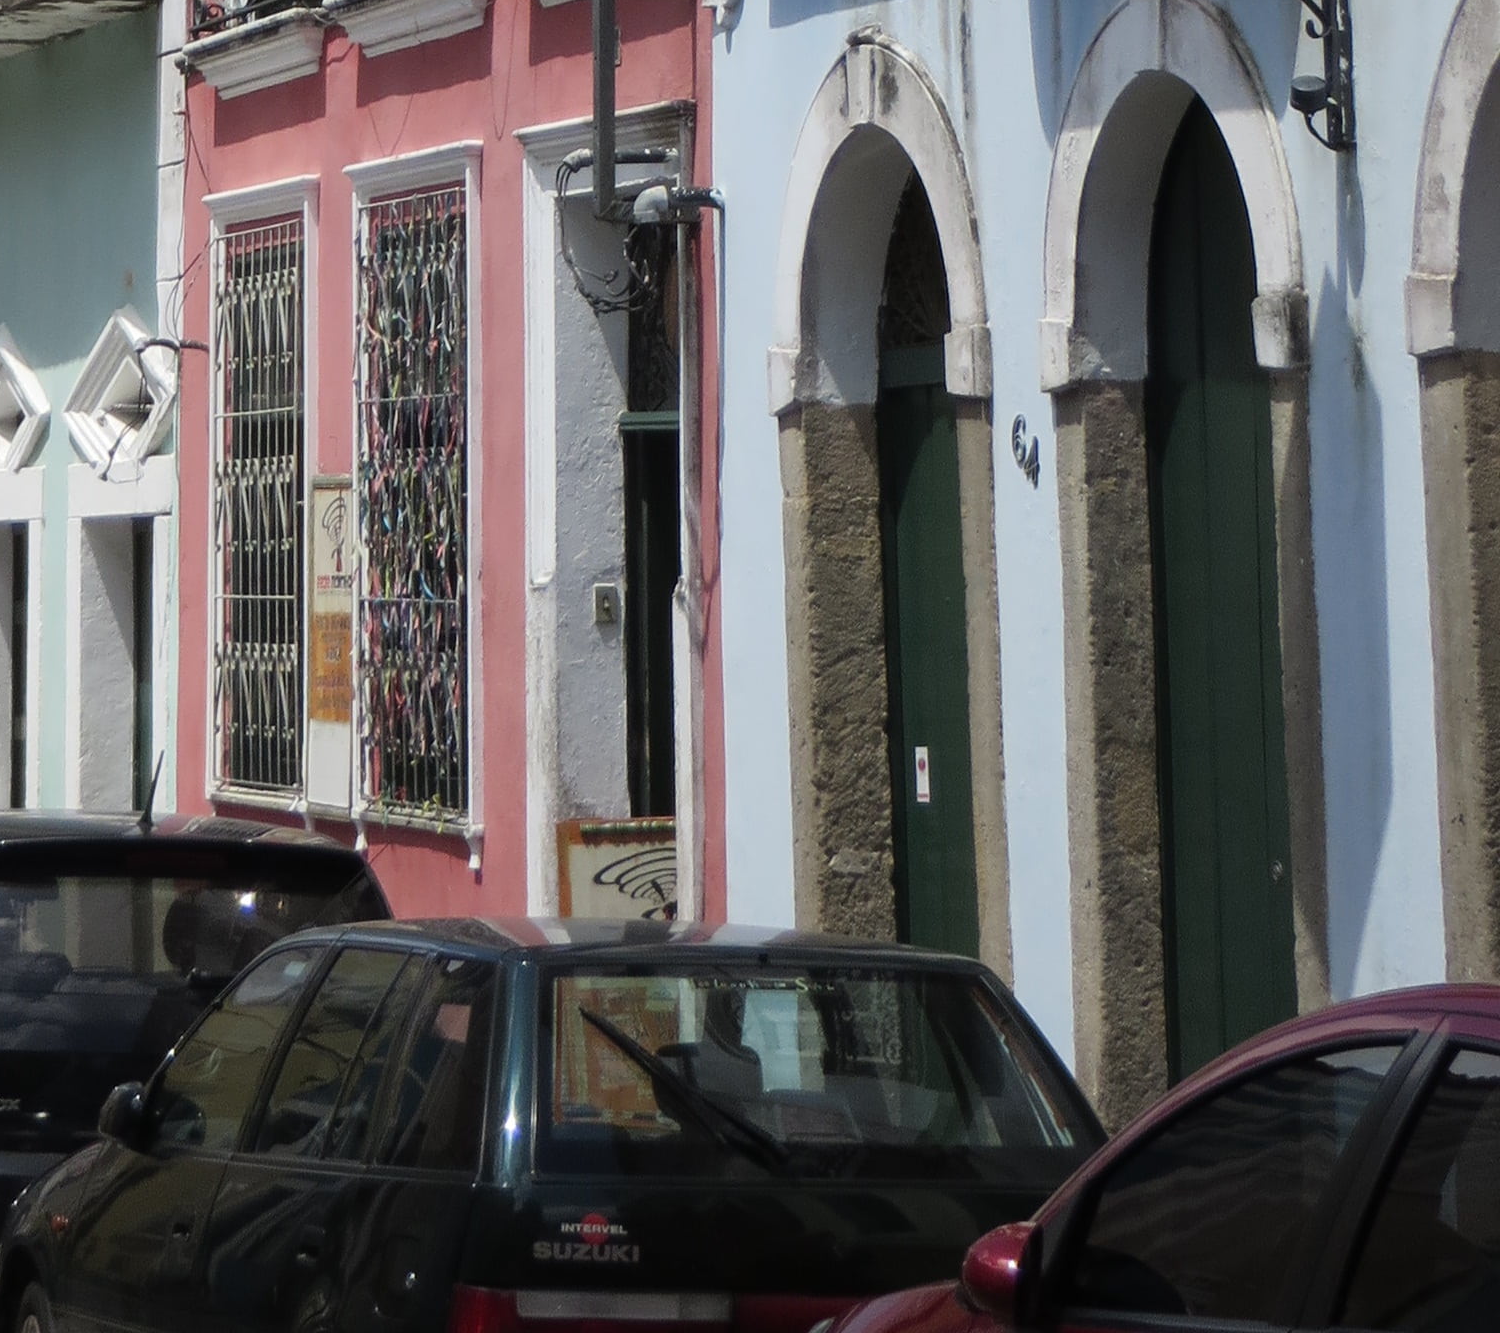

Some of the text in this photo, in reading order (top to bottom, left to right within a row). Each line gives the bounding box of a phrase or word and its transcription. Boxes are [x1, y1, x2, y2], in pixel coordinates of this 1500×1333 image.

[1011, 414, 1040, 489] 64
[560, 1222, 628, 1235] INTERVEL
[533, 1241, 640, 1262] SUZUKI
